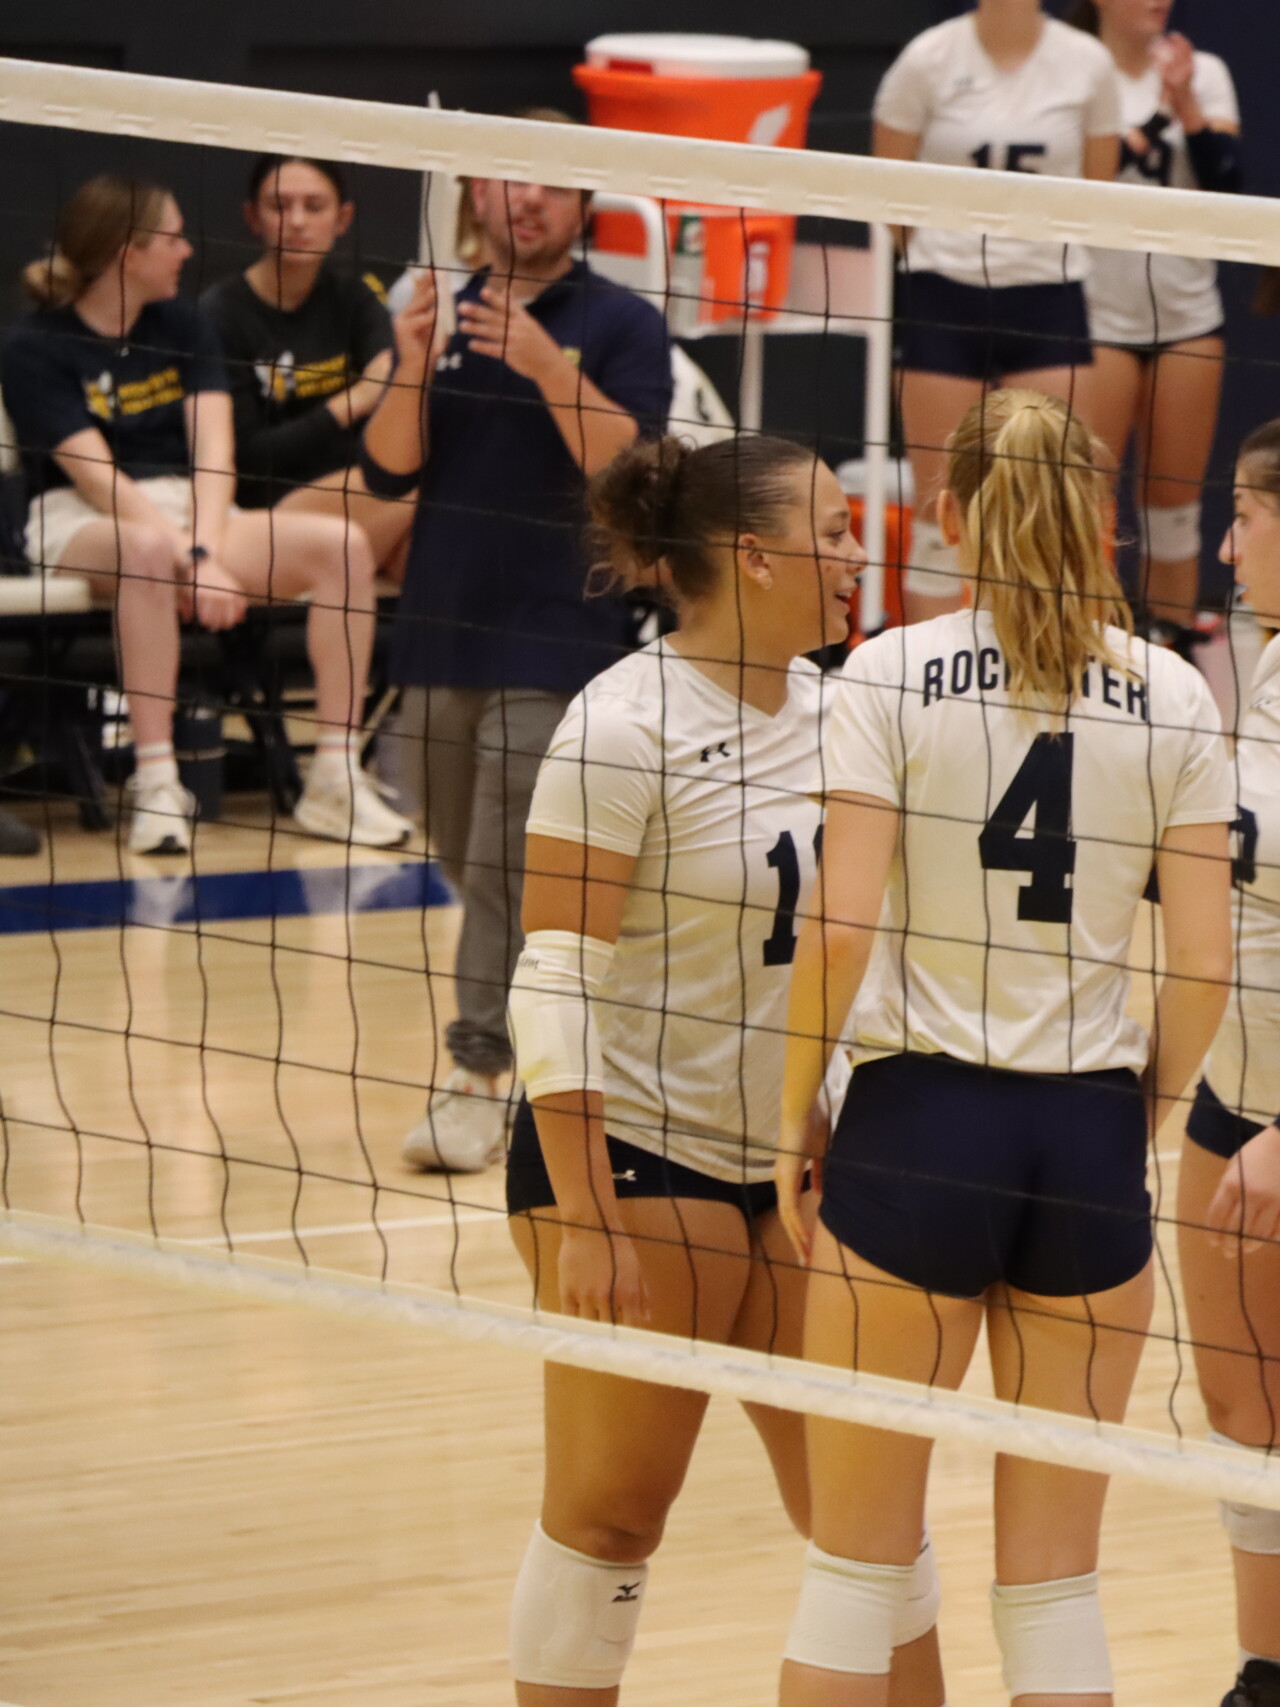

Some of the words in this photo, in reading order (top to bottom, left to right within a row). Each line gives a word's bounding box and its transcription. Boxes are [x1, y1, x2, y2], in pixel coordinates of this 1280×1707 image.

[922, 647, 1148, 721] ROCTER
[763, 823, 825, 967] 1
[978, 732, 1077, 924] 4
